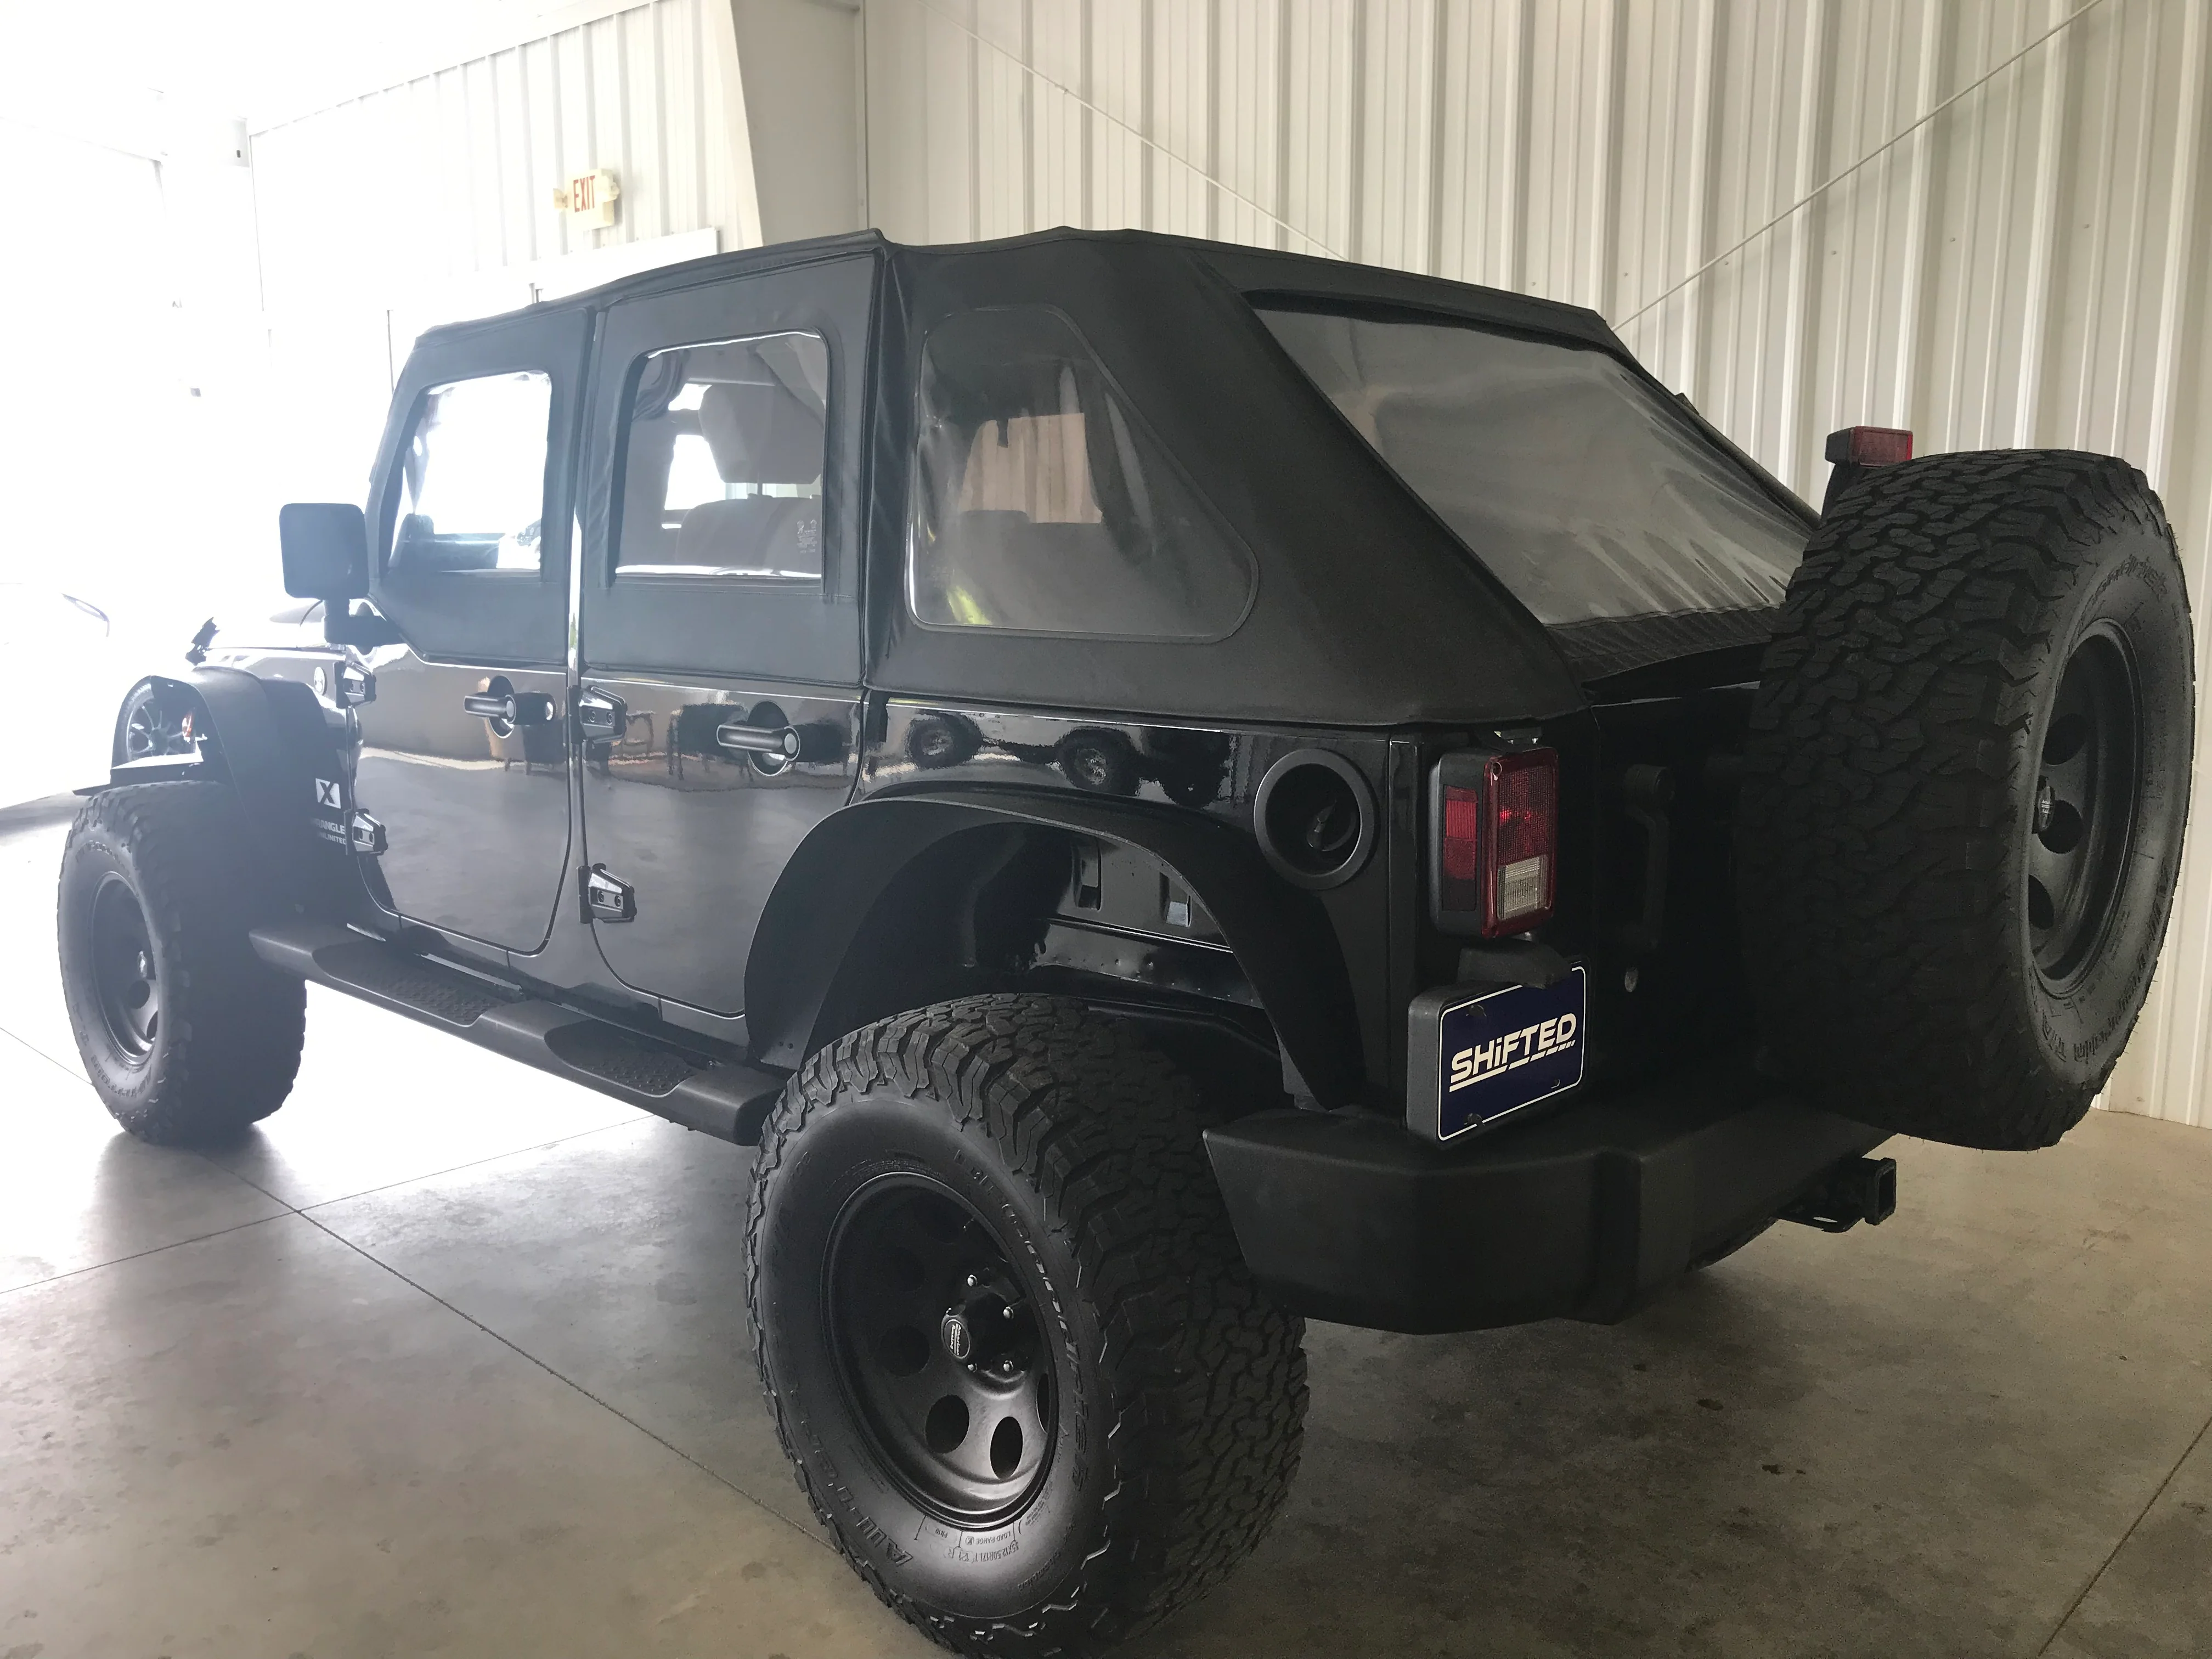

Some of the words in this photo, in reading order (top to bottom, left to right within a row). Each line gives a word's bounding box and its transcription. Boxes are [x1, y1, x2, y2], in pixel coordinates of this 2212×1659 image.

[573, 175, 595, 213] EXIT
[317, 831, 346, 845] LIMITED
[976, 1536, 995, 1545] RANGE
[996, 1531, 1011, 1542] LOAD
